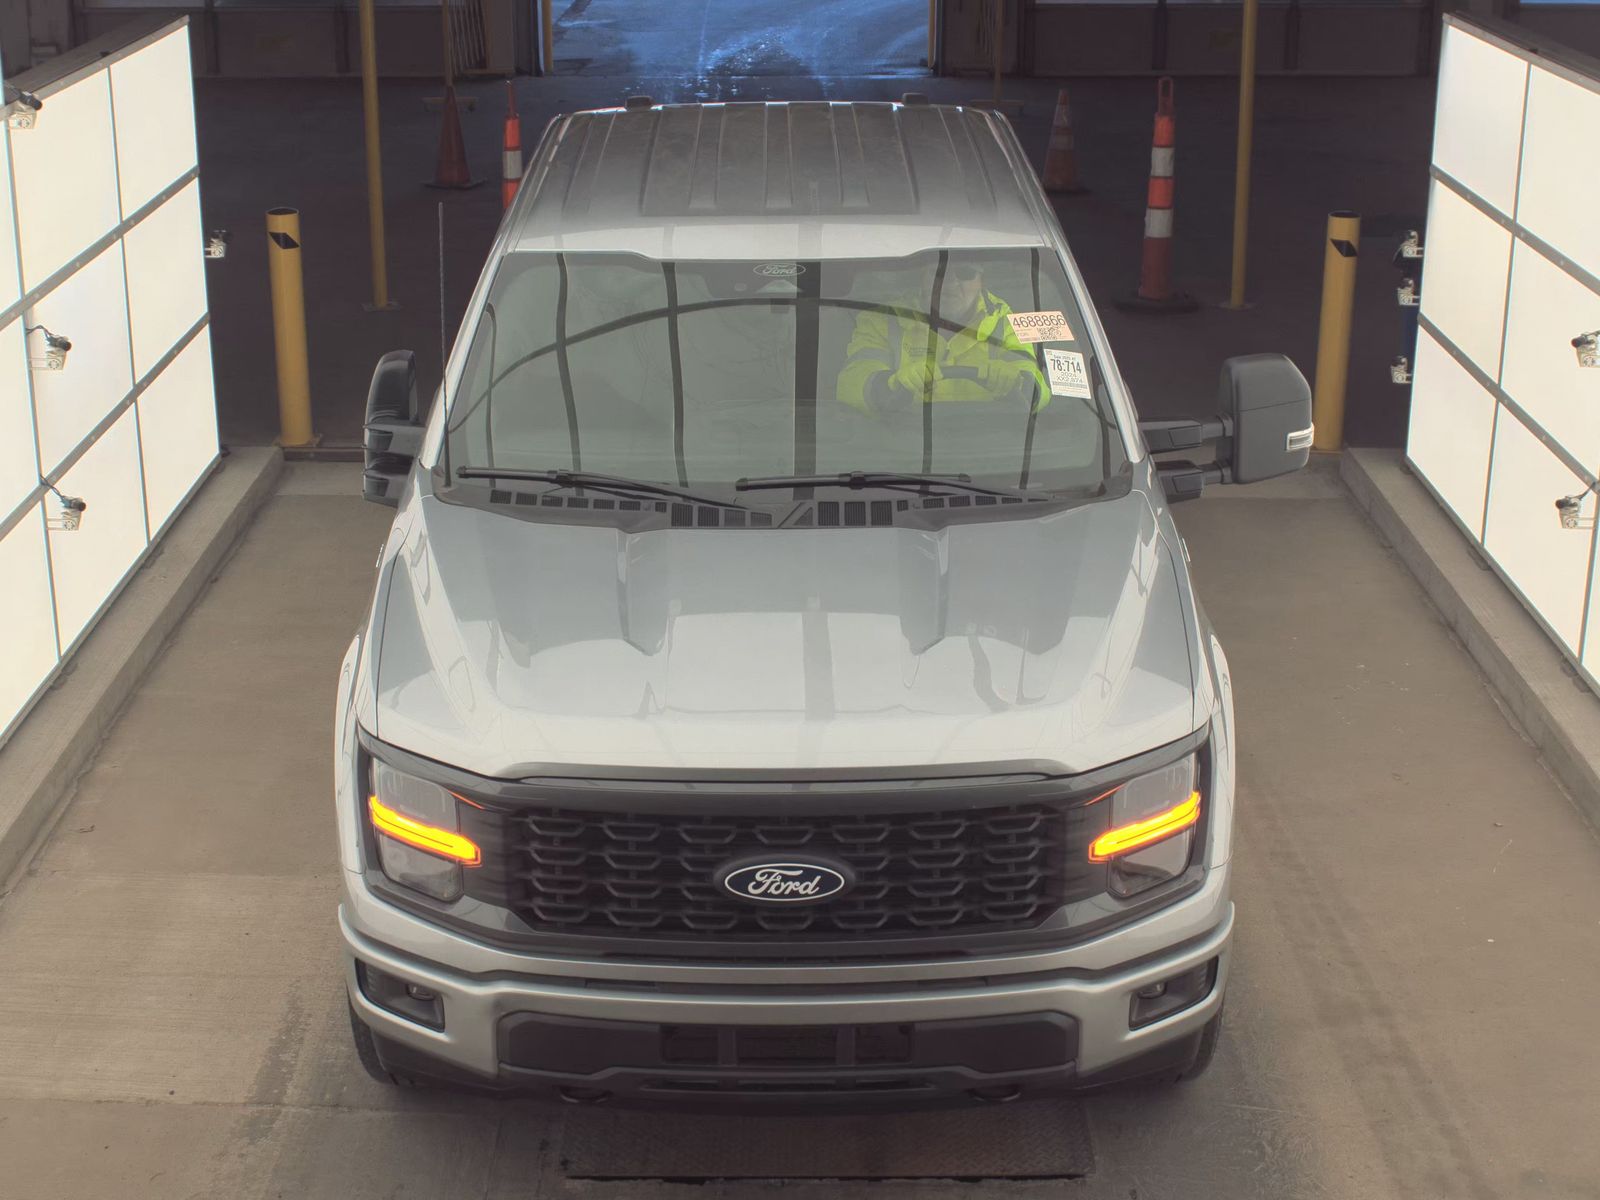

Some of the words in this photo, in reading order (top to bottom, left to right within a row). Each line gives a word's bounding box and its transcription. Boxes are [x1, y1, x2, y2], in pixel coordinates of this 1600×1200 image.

[1013, 315, 1066, 328] 4688866
[1050, 359, 1081, 374] 78:714
[747, 868, 822, 895] Ford
